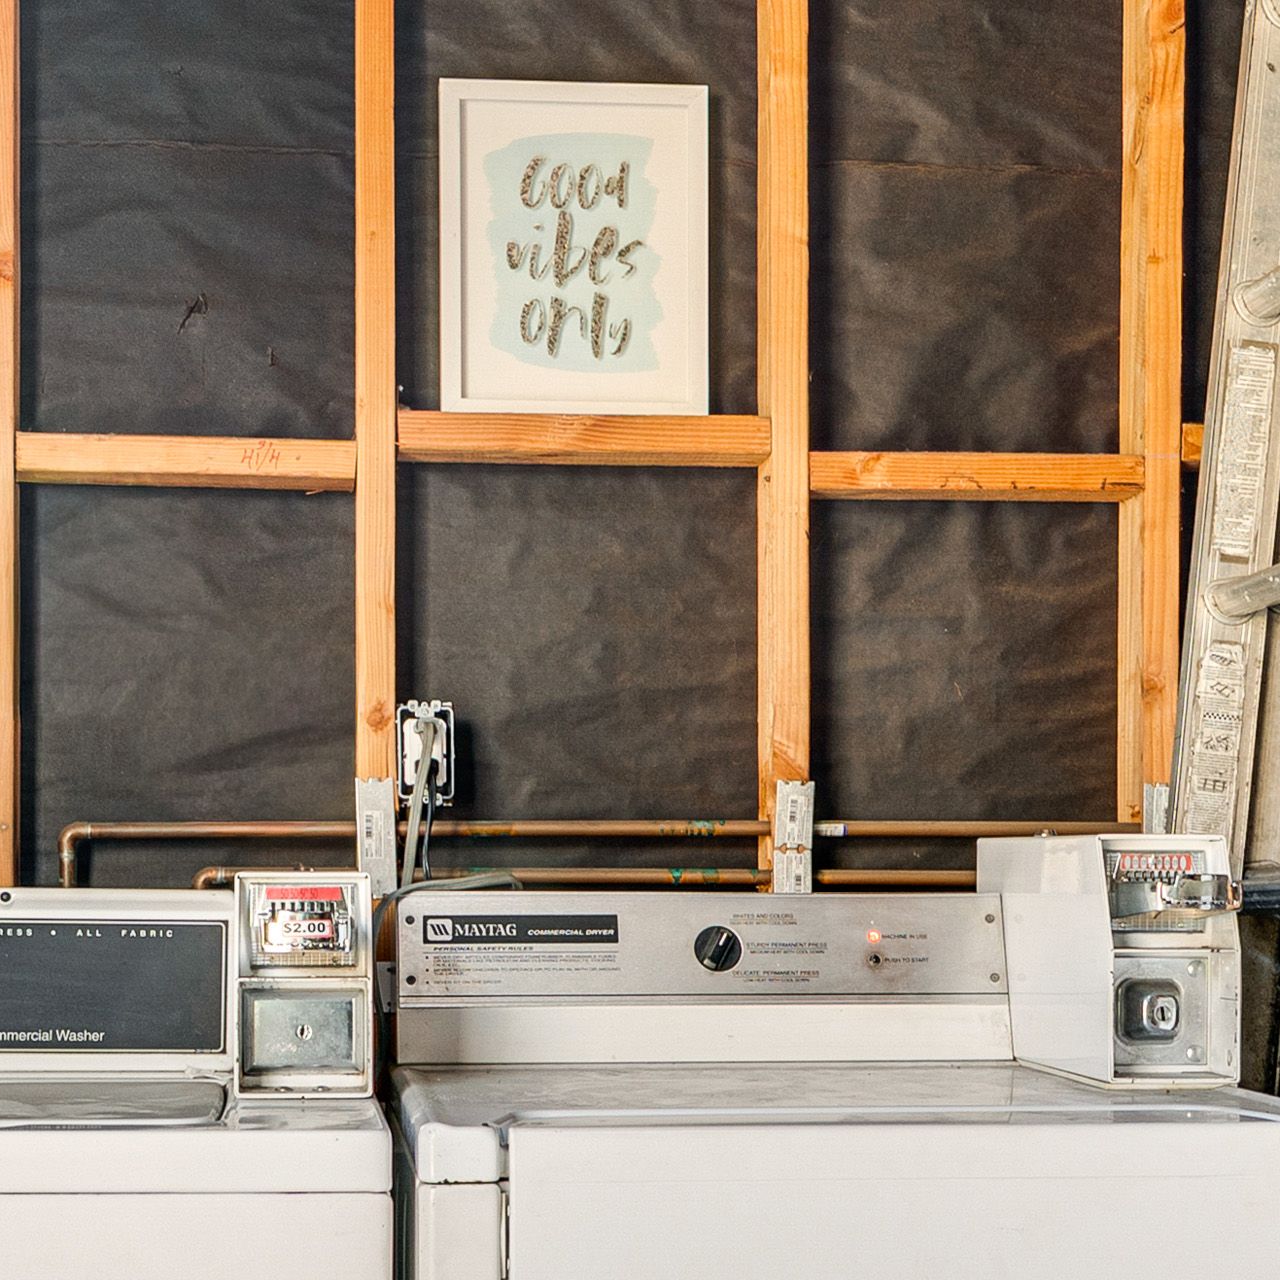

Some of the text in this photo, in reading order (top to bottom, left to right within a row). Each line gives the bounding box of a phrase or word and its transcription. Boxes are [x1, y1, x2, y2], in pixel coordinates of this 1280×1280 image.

[506, 210, 646, 288] vibes
[519, 291, 632, 360] only
[76, 928, 102, 937] ALL
[121, 929, 173, 938] FABRIC
[283, 922, 326, 934] $2.00
[454, 923, 615, 937] MAYTAG COMMERCIAL DRYER
[56, 1028, 105, 1042] Washer
